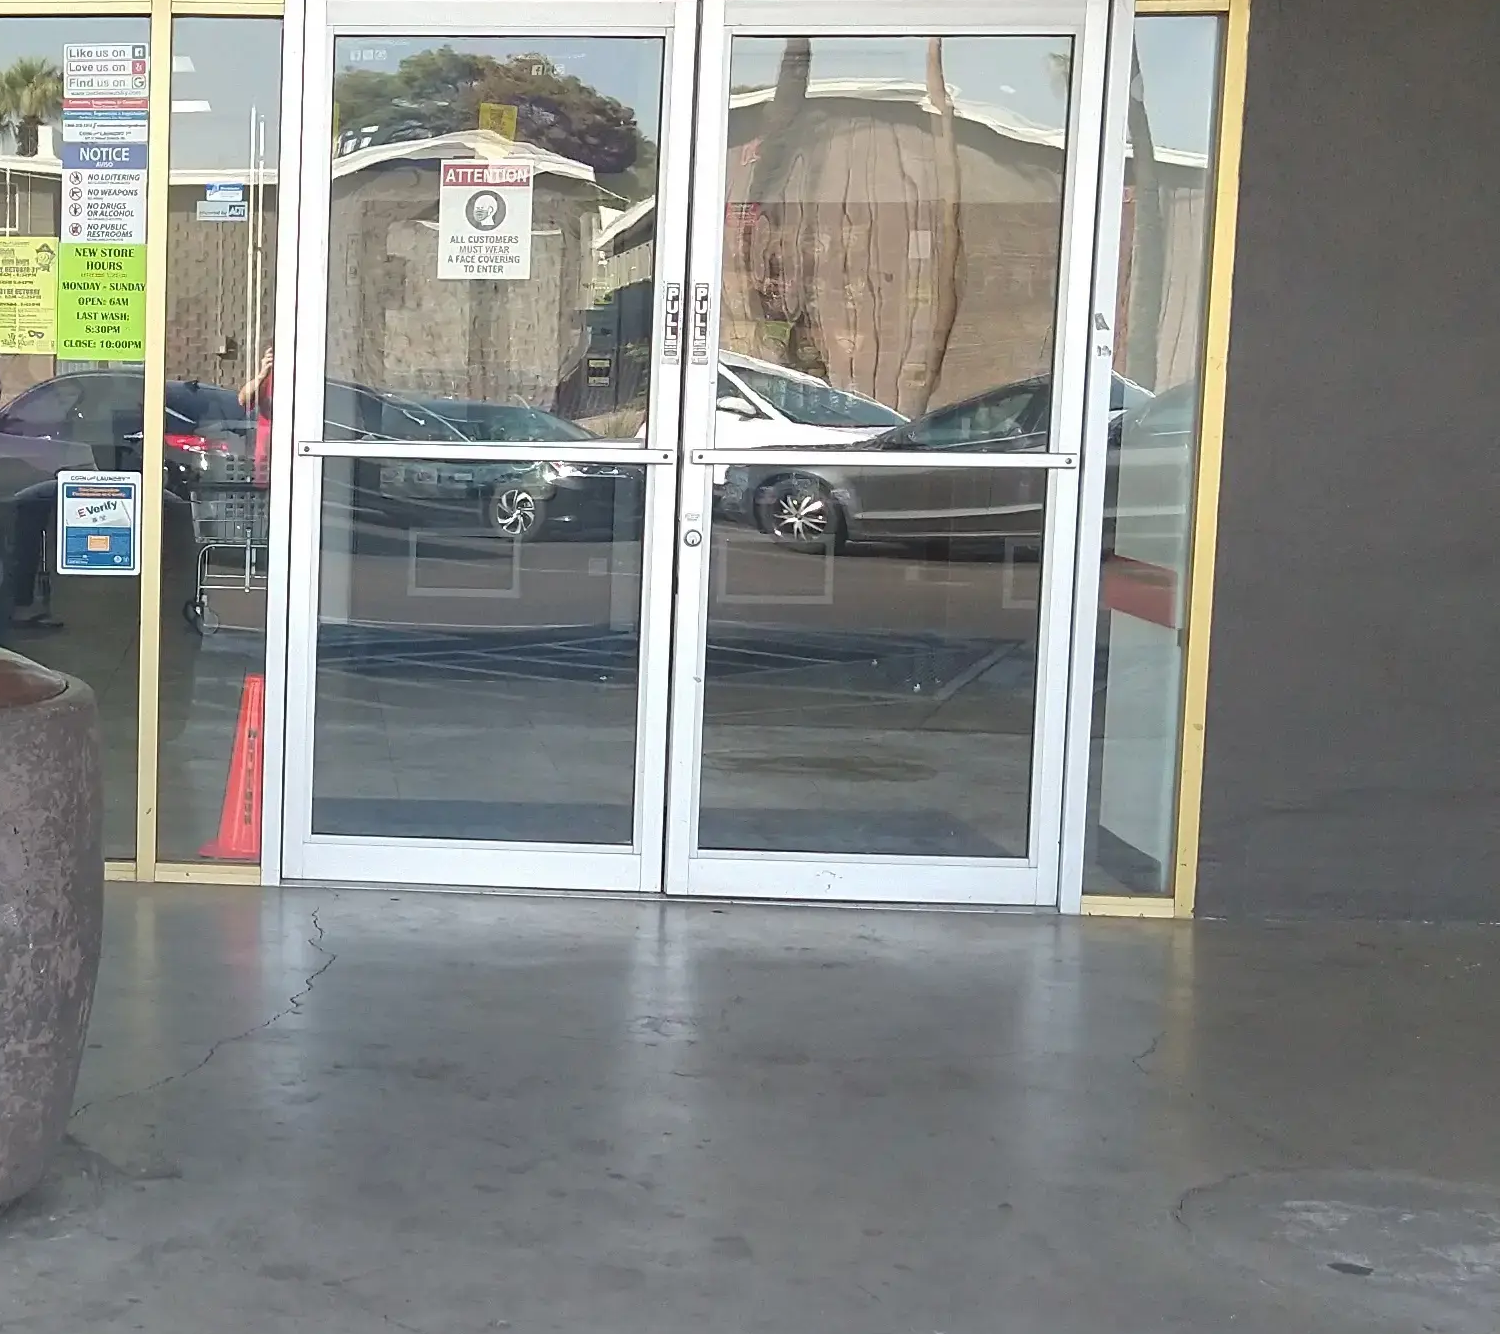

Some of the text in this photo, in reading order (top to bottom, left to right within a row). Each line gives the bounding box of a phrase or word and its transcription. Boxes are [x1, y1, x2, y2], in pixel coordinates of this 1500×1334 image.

[69, 49, 126, 58] Like us on
[69, 63, 126, 72] Love us on
[69, 78, 93, 87] Find
[97, 79, 109, 87] us
[112, 79, 126, 87] on
[79, 147, 130, 161] NOTICE
[445, 168, 528, 183] ATTENTION
[100, 189, 138, 197] WEAPONS
[450, 236, 519, 244] ALL CUSTOMERS
[75, 248, 135, 257] NEW STORE
[460, 246, 510, 254] MUST WEAR
[455, 255, 475, 263] FACE
[478, 255, 520, 264] COVERING
[86, 261, 123, 270] HOURS
[464, 265, 504, 273] TO ENTER
[62, 282, 101, 291] MONDAY
[109, 283, 146, 291] SUNDAY
[78, 297, 129, 306] OPEN: 6AM
[76, 312, 130, 321] LAST WASH:
[666, 287, 679, 340] PULL
[694, 287, 708, 340] PULL
[85, 325, 120, 333] 8:30PM
[63, 339, 142, 348] CLOSE: 10:00PM
